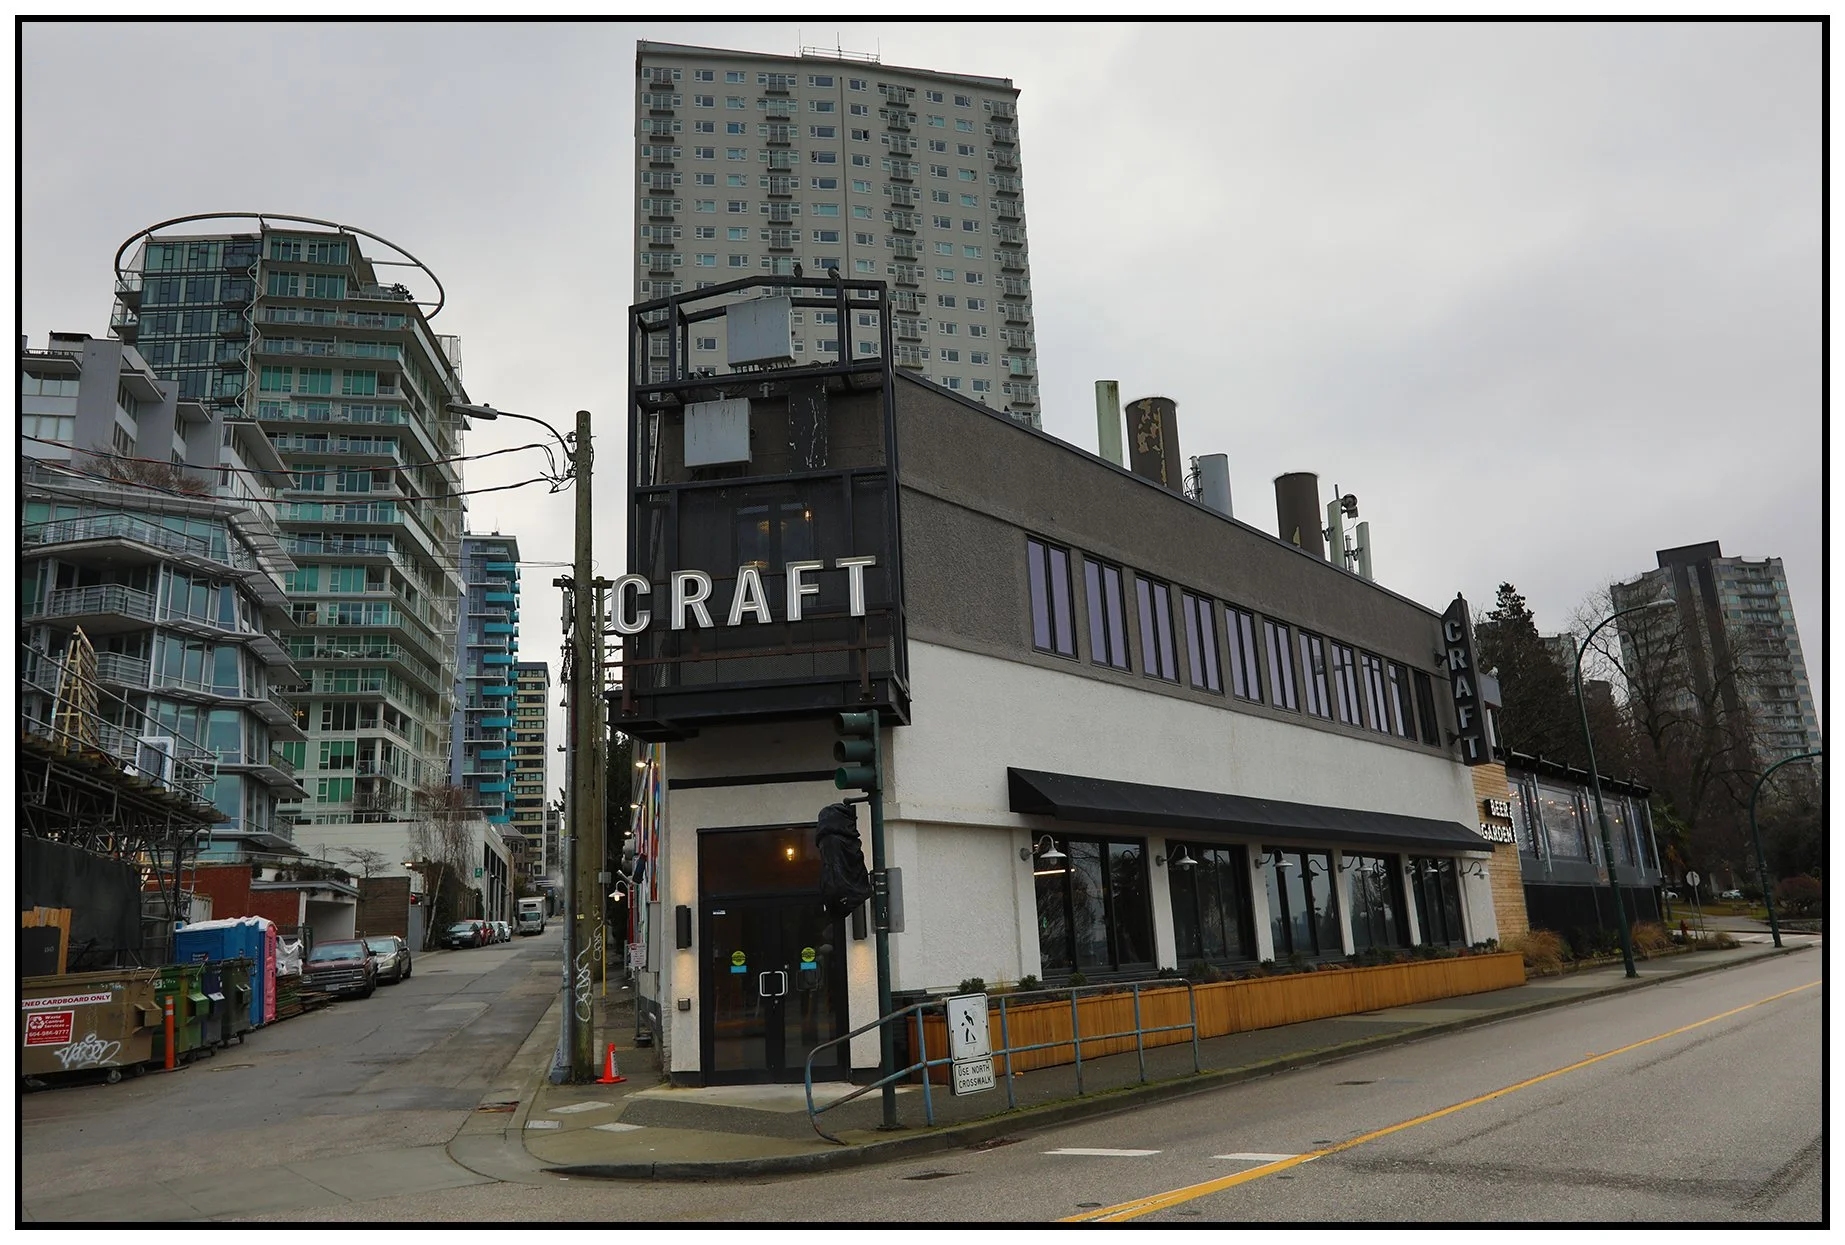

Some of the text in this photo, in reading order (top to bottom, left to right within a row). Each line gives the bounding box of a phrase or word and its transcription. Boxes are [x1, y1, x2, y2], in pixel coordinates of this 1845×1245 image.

[610, 555, 877, 635] CRAFT
[1444, 617, 1480, 760] CRAFT
[1489, 799, 1510, 818] BEER
[1480, 823, 1515, 844] GARDEN
[41, 995, 89, 1006] CARDBOARD
[958, 1064, 990, 1076] USE NORTH
[958, 1076, 992, 1088] CROSSWALK
